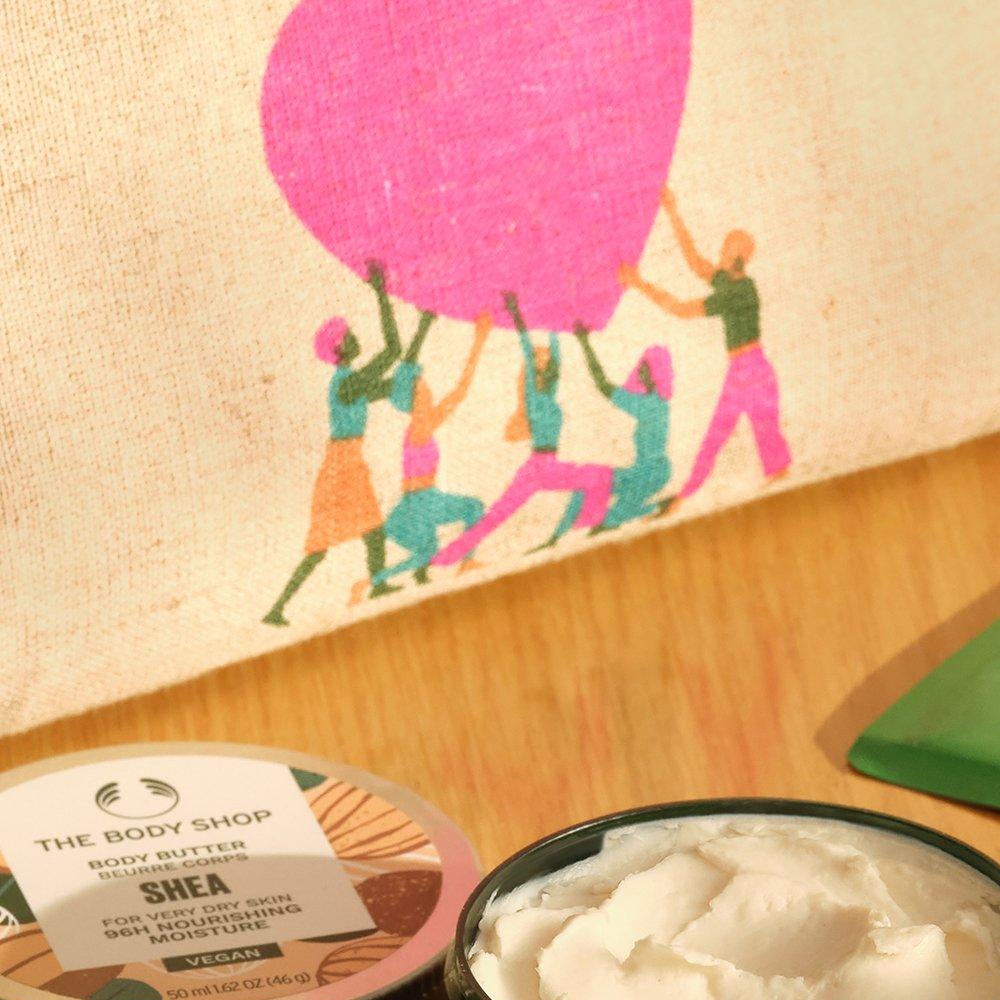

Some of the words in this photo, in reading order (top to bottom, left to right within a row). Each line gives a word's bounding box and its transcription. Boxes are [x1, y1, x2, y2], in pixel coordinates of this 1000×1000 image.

[34, 833, 96, 853] THE
[103, 822, 183, 845] BODY
[192, 810, 274, 832] SHOP
[88, 853, 149, 870] BODY
[157, 840, 249, 861] BUTTER
[99, 862, 179, 881] BEURRE
[183, 852, 250, 869] CORPS
[139, 873, 232, 904] SHEA
[102, 914, 143, 928] FOR
[146, 906, 198, 923] VERY
[202, 900, 242, 915] DRY
[246, 893, 294, 908] SKIN
[103, 925, 152, 940] 96H
[156, 903, 304, 932] NOURISHING
[149, 920, 271, 945] MOISTURE
[184, 948, 262, 968] VEGAN
[166, 986, 190, 1000] 50
[191, 982, 213, 998] ml
[213, 980, 241, 994] 1.62
[243, 976, 266, 991] OZ
[266, 973, 293, 989] (46
[294, 971, 313, 985] g)
